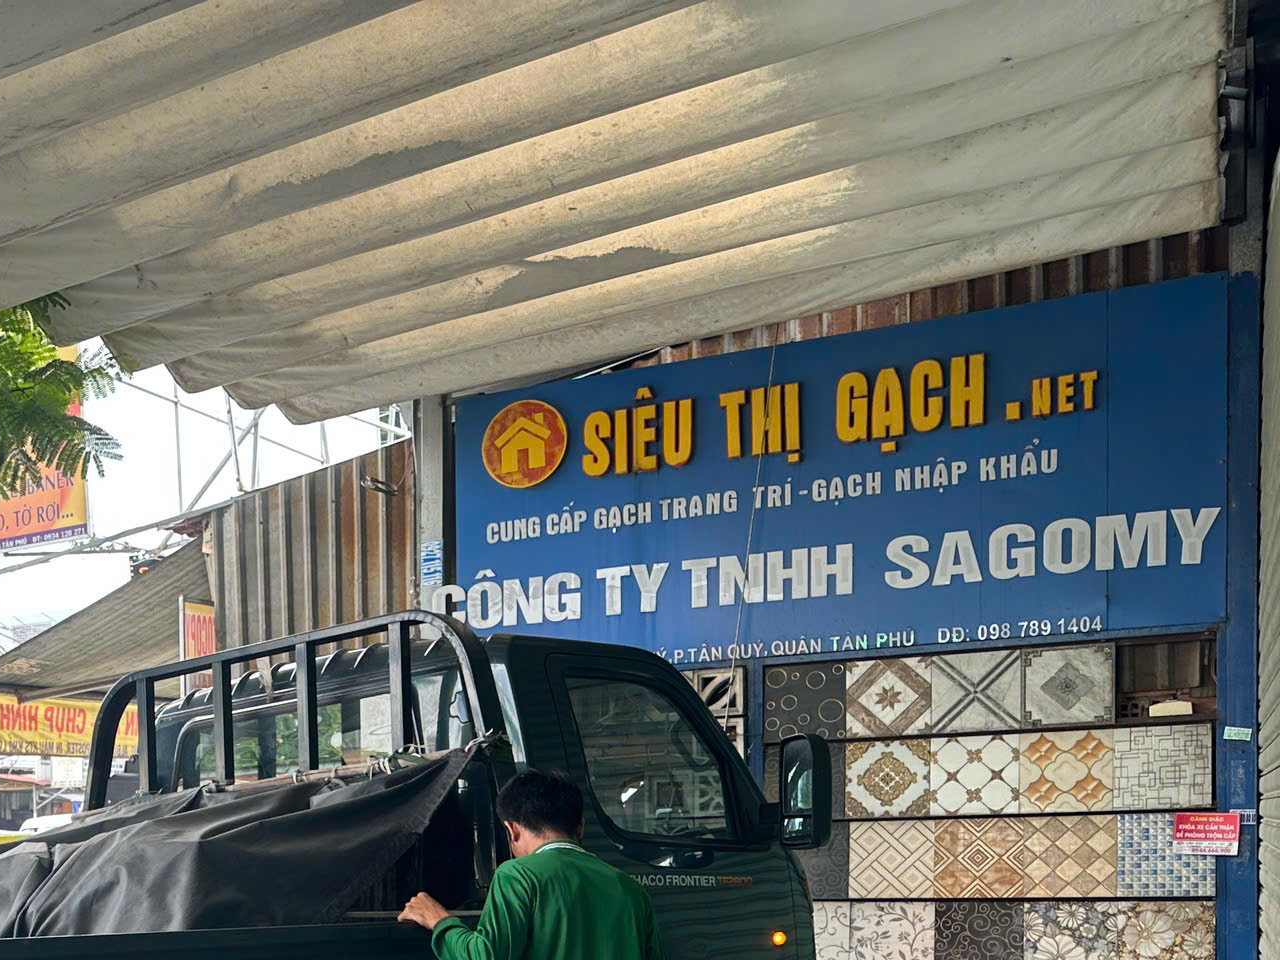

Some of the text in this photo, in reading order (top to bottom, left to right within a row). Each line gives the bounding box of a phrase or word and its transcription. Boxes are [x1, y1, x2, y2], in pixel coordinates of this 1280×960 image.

[582, 386, 693, 477] SIÊU
[718, 382, 801, 463] THỊ
[835, 352, 985, 453] GẠCH
[486, 515, 541, 544] CUNG
[546, 501, 587, 534] CẤP
[594, 502, 652, 534] GẠCH
[659, 490, 737, 521] TRANG
[895, 457, 968, 493] NHẬP
[979, 438, 1058, 482] KHẨU
[432, 506, 1222, 629] CÔNG TY TNHH SAGOMY
[876, 627, 915, 648] PHÚ
[977, 623, 1011, 641] 098
[1018, 619, 1052, 638] 789
[1057, 615, 1103, 635] 1404
[666, 875, 716, 887] FRONTIER
